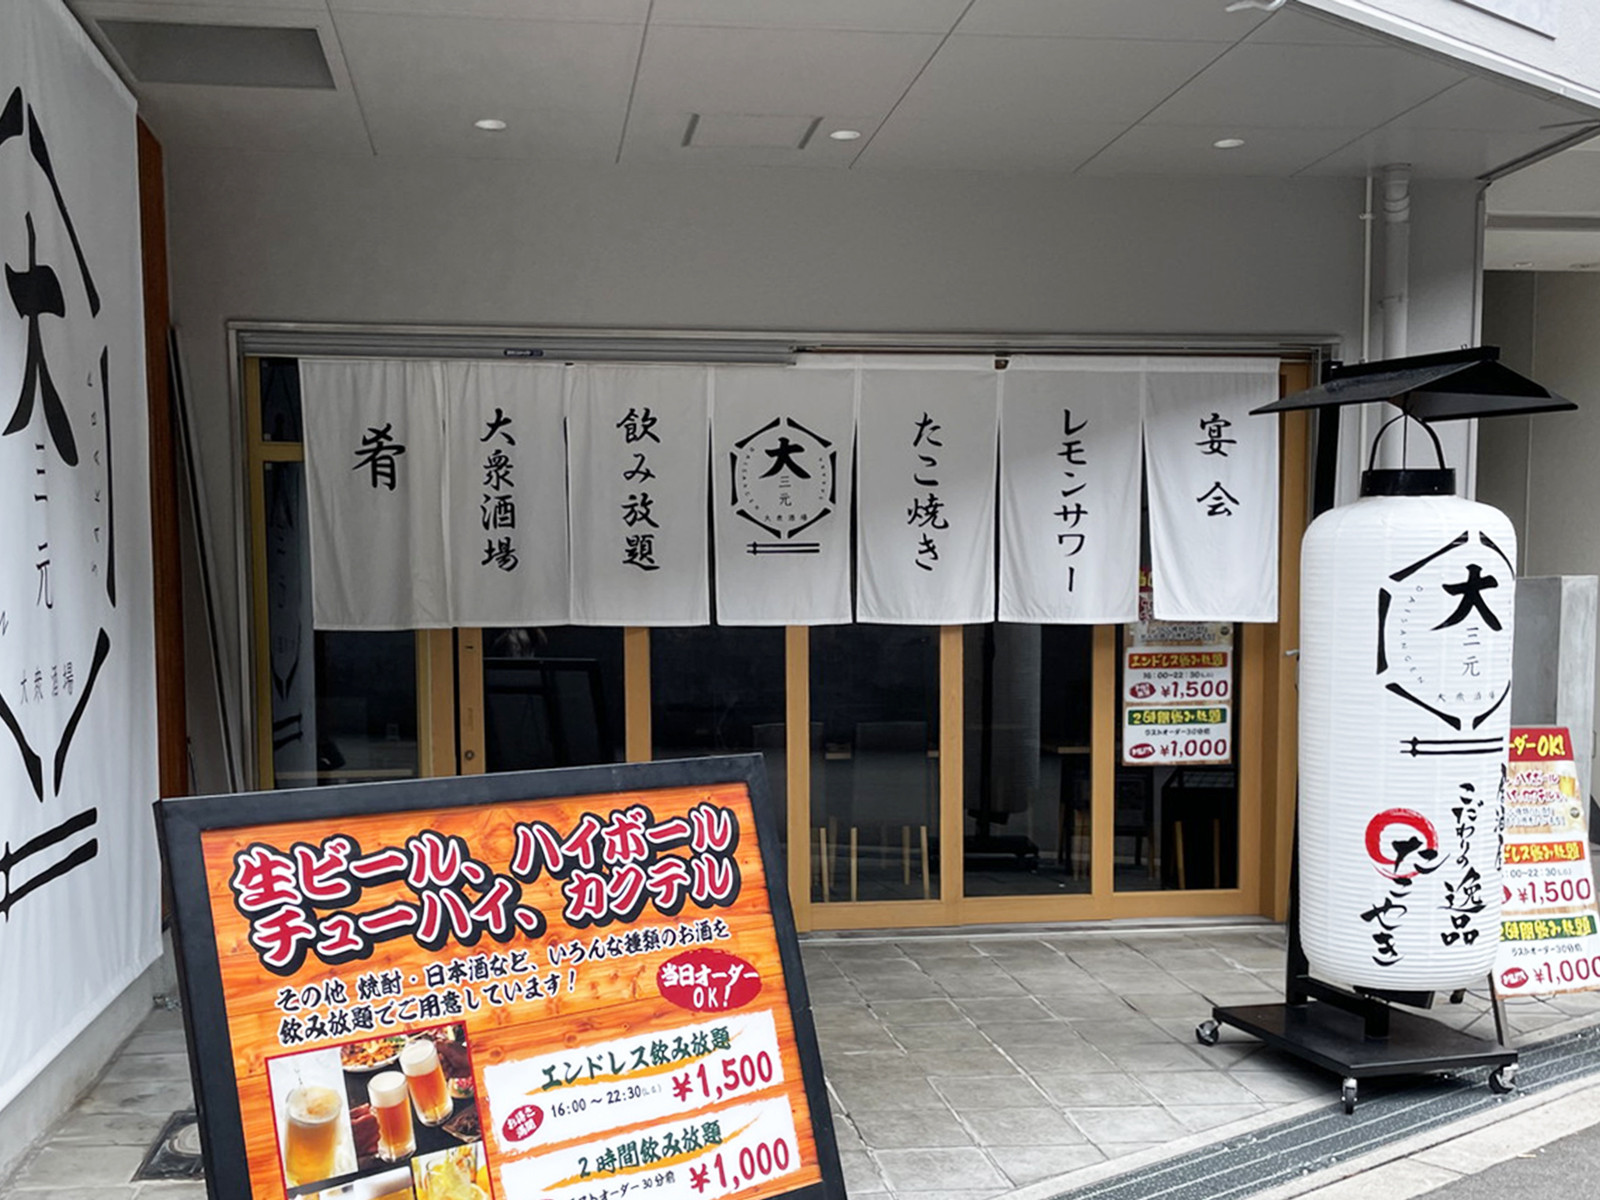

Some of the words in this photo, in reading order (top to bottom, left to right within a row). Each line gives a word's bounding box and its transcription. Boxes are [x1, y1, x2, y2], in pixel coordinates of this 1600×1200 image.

[352, 423, 406, 491] 肴
[1195, 413, 1240, 517] 宴会
[480, 407, 518, 571] 大衆酒場
[616, 407, 661, 571] 飲み放題
[907, 412, 949, 571] たこ焼き
[1053, 409, 1088, 592] レモンサワー
[1161, 680, 1228, 698] ¥1,500
[1160, 739, 1227, 757] ¥1,000
[1437, 783, 1487, 946] こだわりの逸品
[1517, 878, 1591, 904] ¥1,500
[1360, 836, 1449, 967] たこやき
[276, 979, 348, 1012] その他
[661, 964, 759, 988] 当日オーダー
[693, 986, 731, 1008] OK!
[541, 1026, 731, 1091] エンドレス飲み放題
[672, 1051, 773, 1103] ¥1,500
[578, 1119, 723, 1179] 2時間飲み放題
[689, 1137, 789, 1194] ¥1,000
